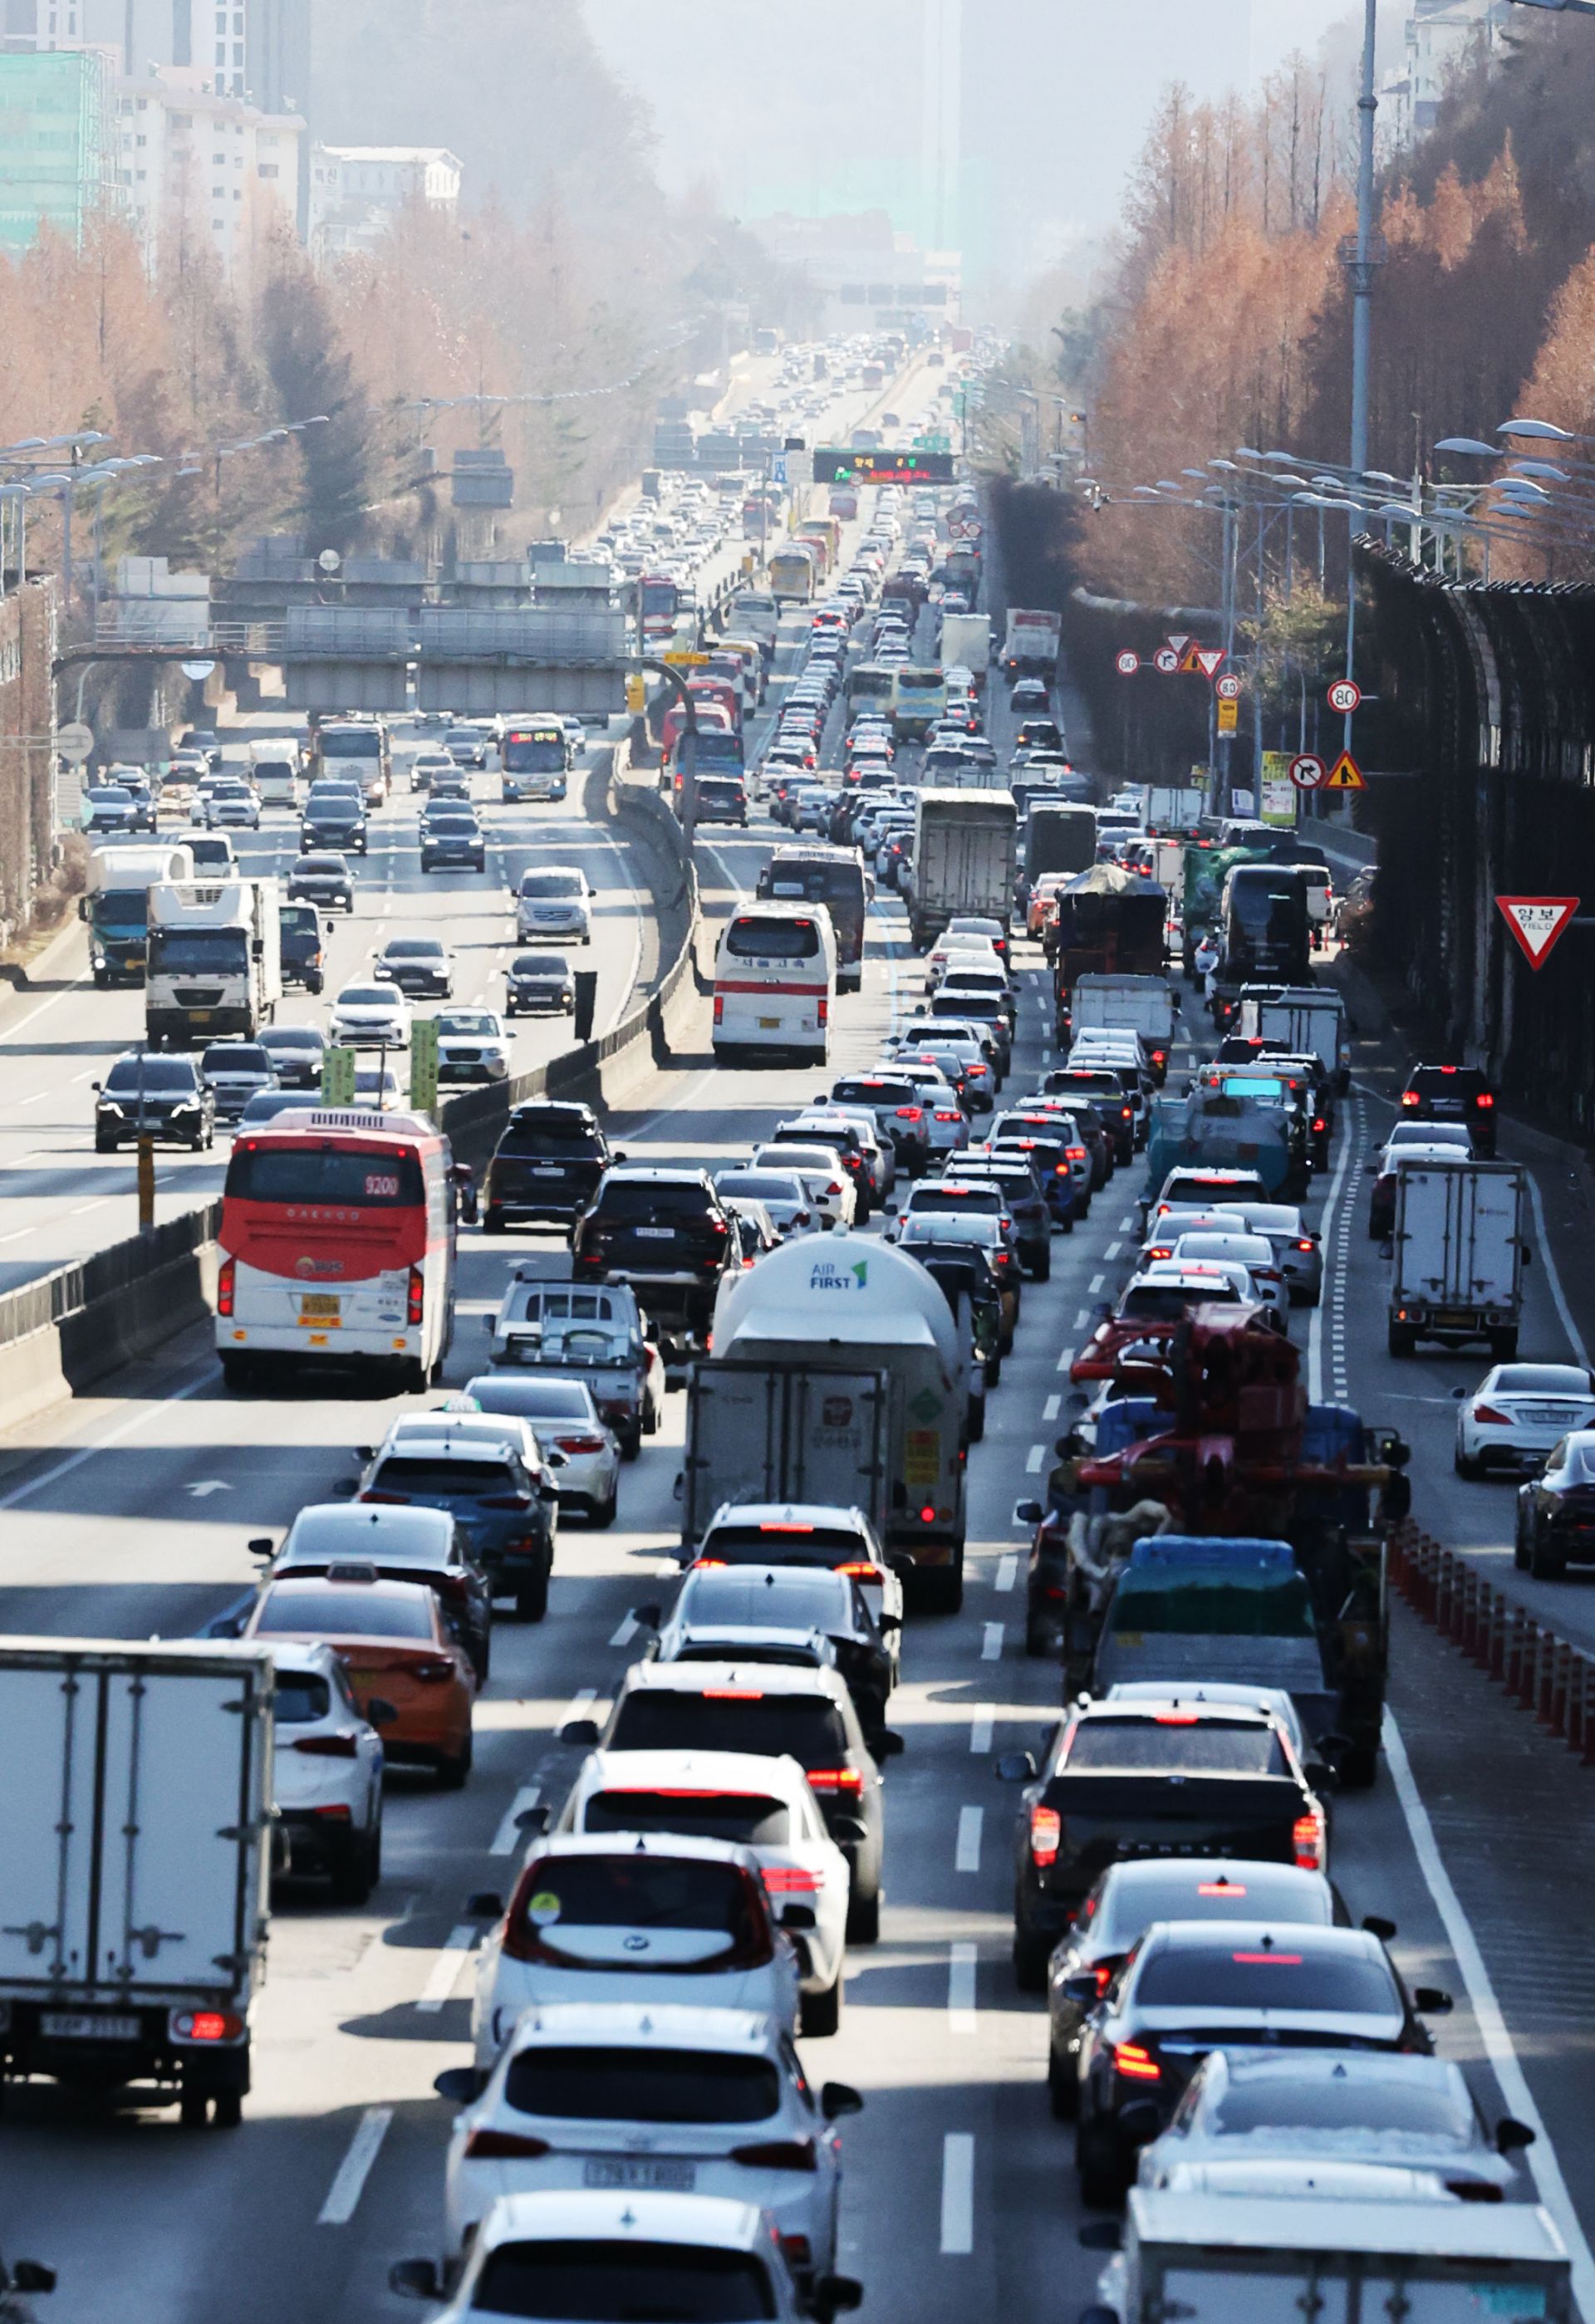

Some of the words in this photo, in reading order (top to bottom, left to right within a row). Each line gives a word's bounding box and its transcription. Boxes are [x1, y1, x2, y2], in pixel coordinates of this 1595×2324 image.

[1121, 657, 1135, 668] 80
[1222, 683, 1236, 694] 80
[1336, 690, 1355, 705] 80
[1518, 908, 1554, 921] 양보
[1522, 922, 1552, 930] YIELD
[366, 1175, 399, 1195] 9200
[812, 1263, 835, 1276] AIR
[810, 1277, 851, 1290] FIRST
